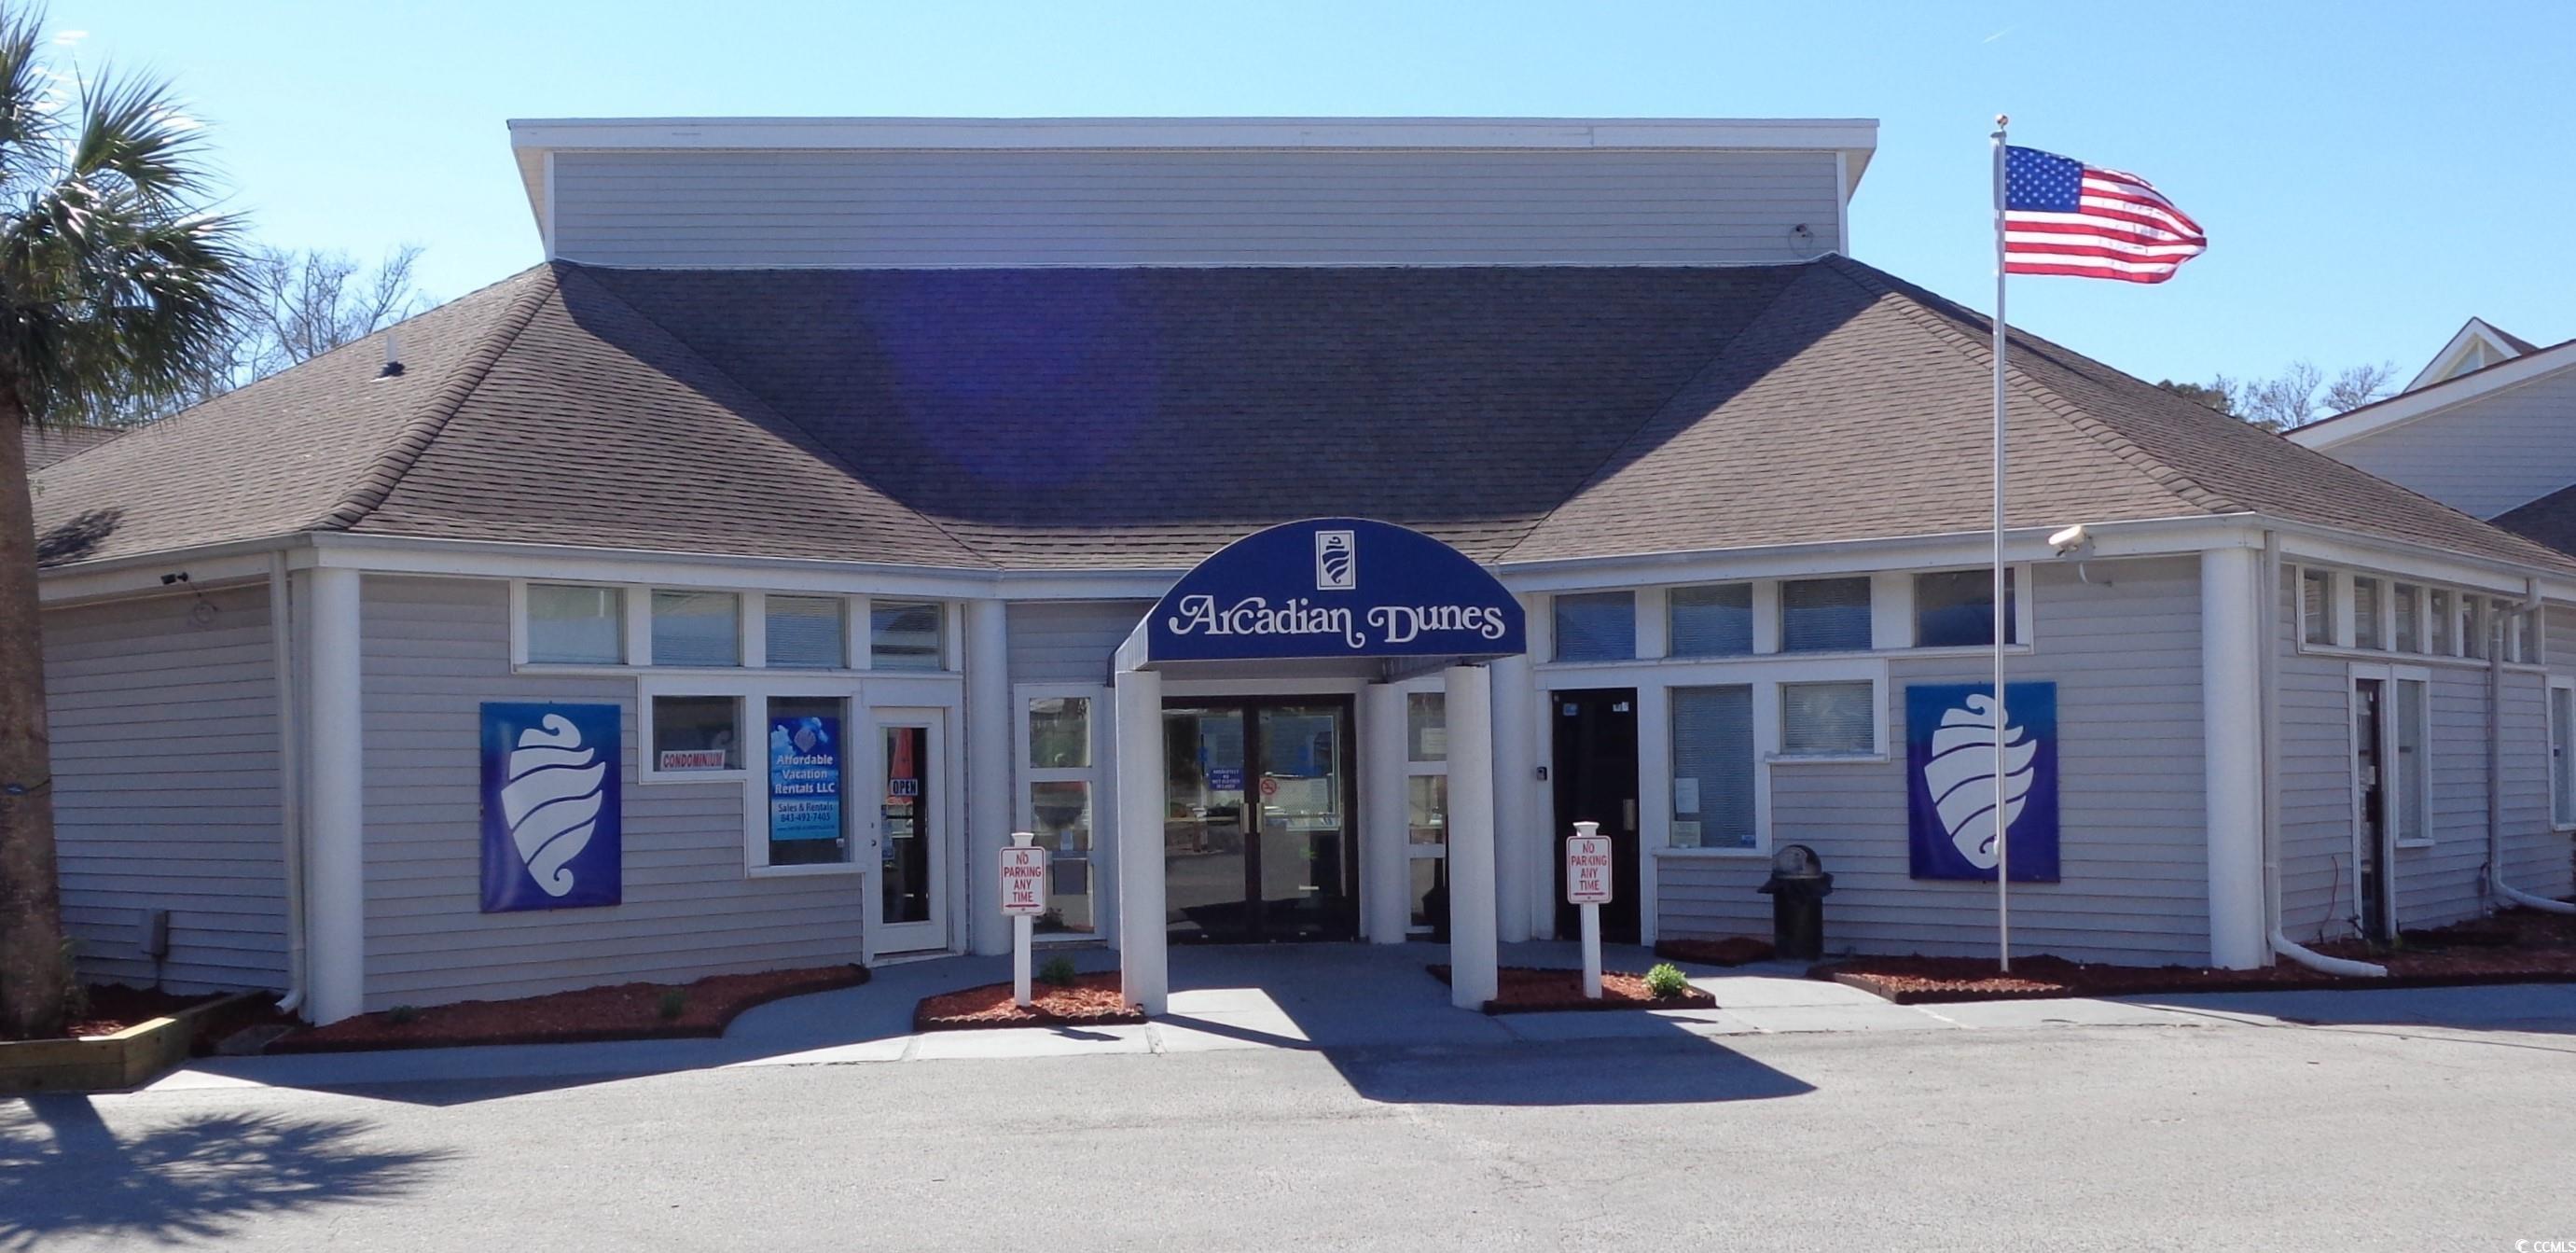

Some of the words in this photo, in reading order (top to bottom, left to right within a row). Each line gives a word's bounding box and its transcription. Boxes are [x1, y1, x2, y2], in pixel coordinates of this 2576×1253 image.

[1169, 594, 1366, 649] Arcadian
[1367, 604, 1506, 644] Dunes
[663, 751, 723, 769] CONDOMINIUM
[776, 754, 834, 765] Affordable
[782, 769, 828, 780] Vacation
[774, 783, 814, 794] Rentals
[816, 782, 836, 793] LLC
[893, 780, 917, 795] OPEN
[778, 802, 797, 813] Sales
[799, 802, 804, 812] &
[806, 801, 834, 812] Rentals
[1583, 842, 1595, 854] NO
[1016, 854, 1030, 865] NO
[1571, 855, 1607, 866] PARKING
[1004, 867, 1042, 878] PARKING
[1580, 868, 1599, 879] ANY
[1013, 879, 1032, 890] ANY
[1579, 880, 1600, 891] TIME
[1012, 891, 1033, 902] TIME
